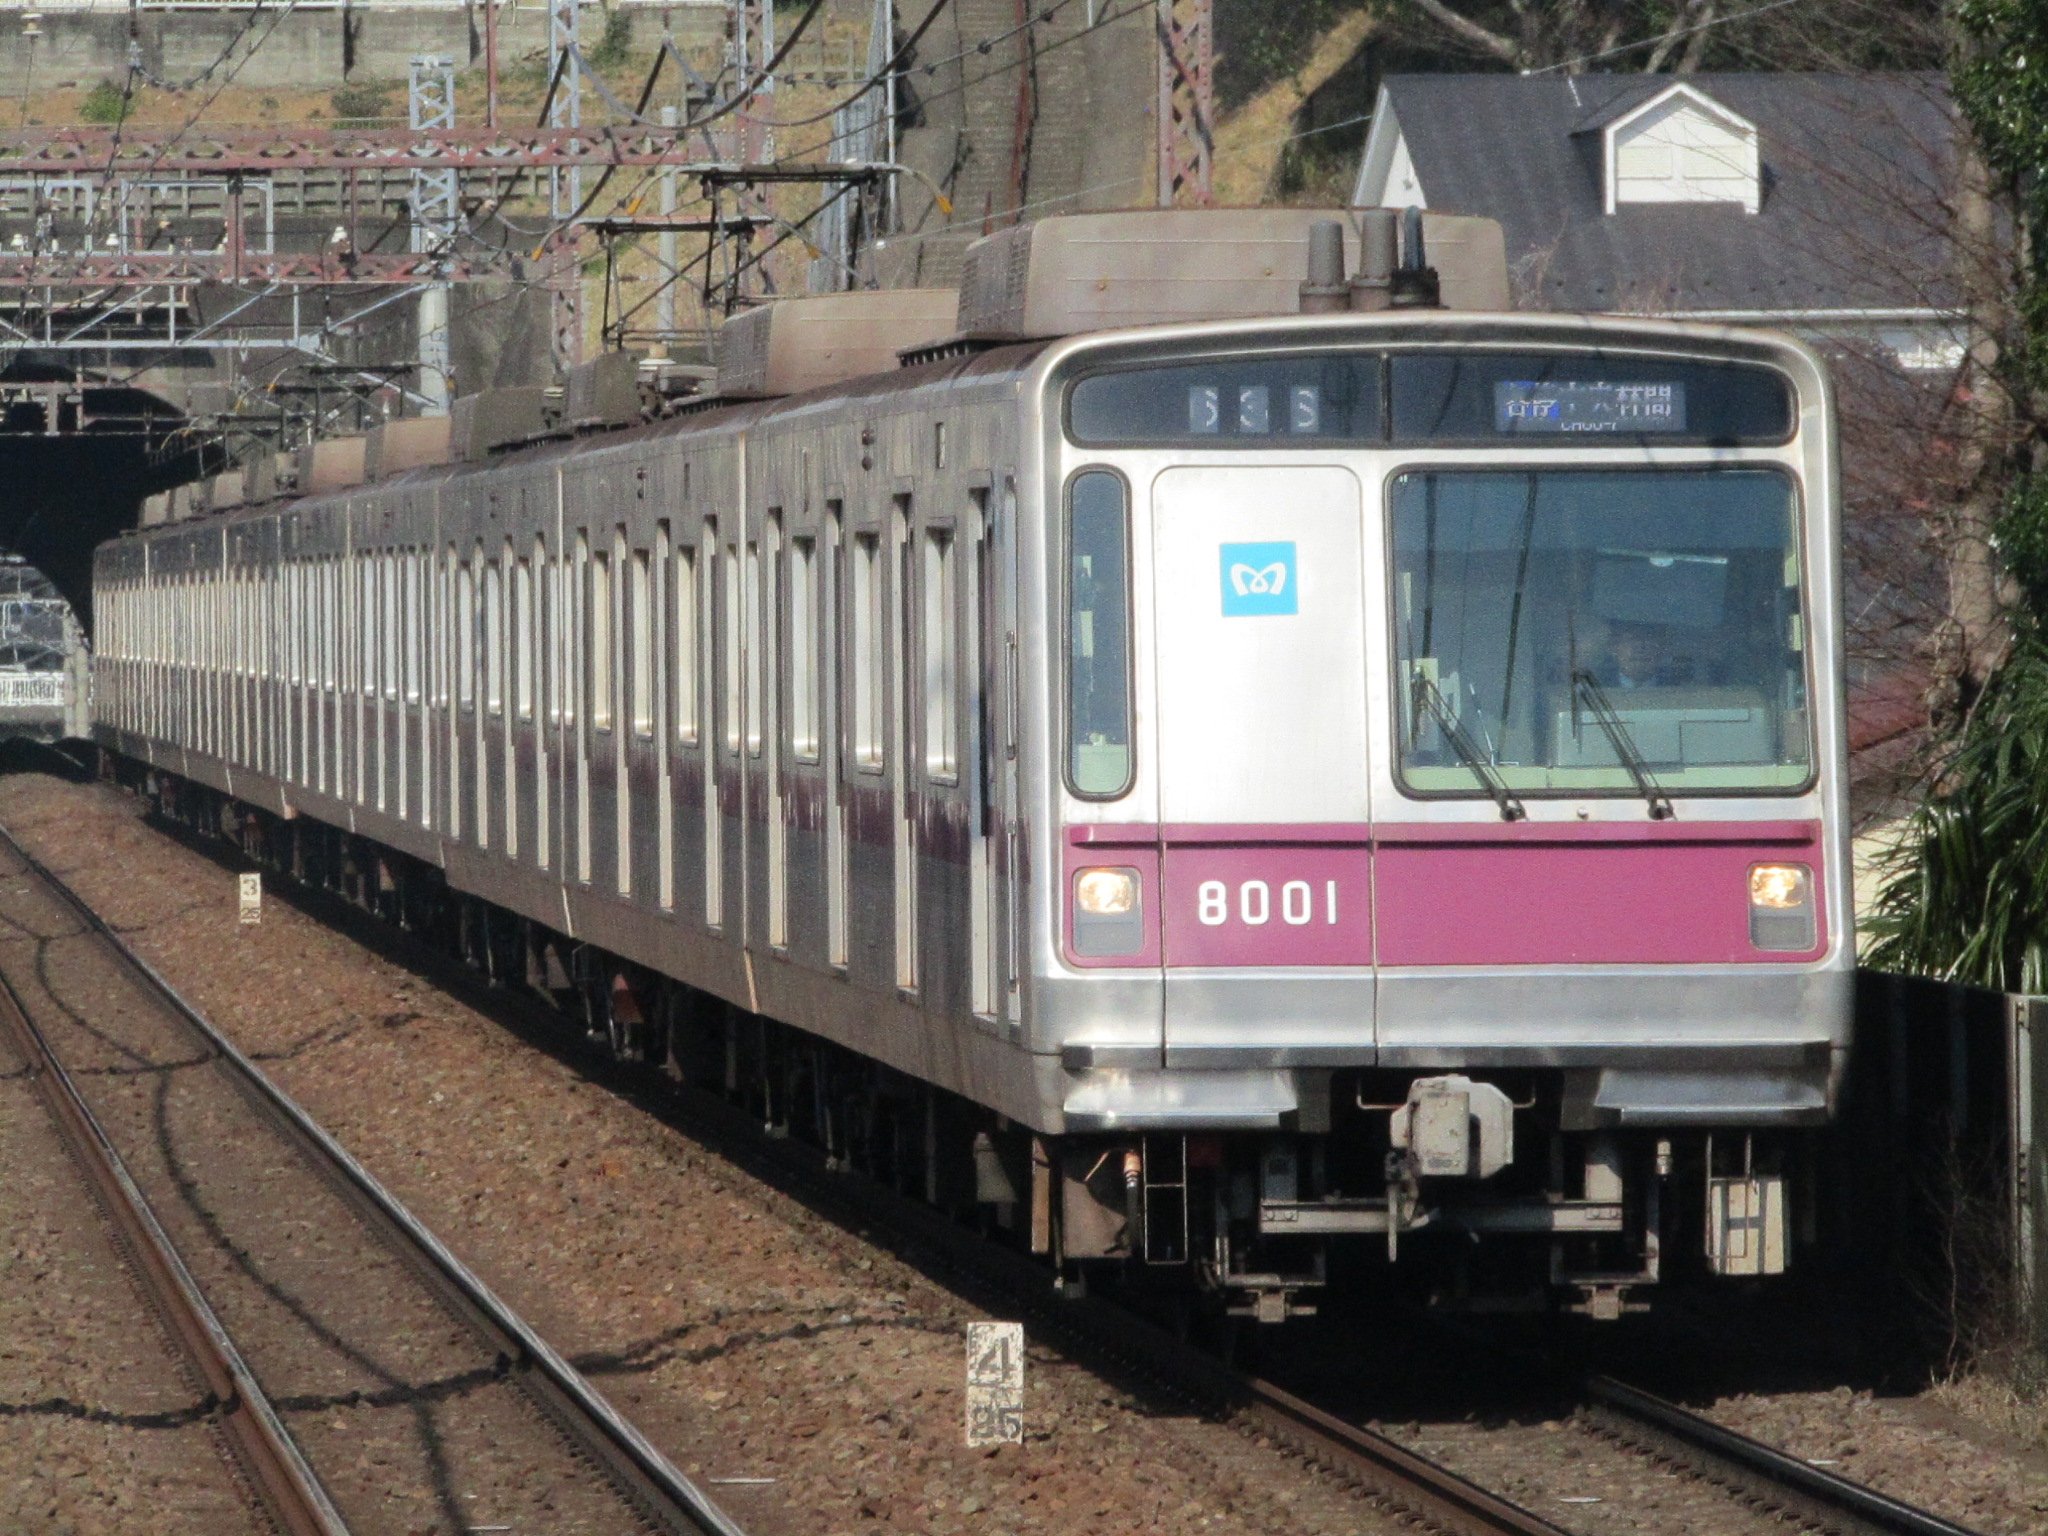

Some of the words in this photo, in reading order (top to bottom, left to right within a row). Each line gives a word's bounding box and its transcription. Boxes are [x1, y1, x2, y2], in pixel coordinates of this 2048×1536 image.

[242, 878, 258, 896] 3
[1199, 880, 1337, 925] 8001
[976, 1337, 1017, 1381] 4
